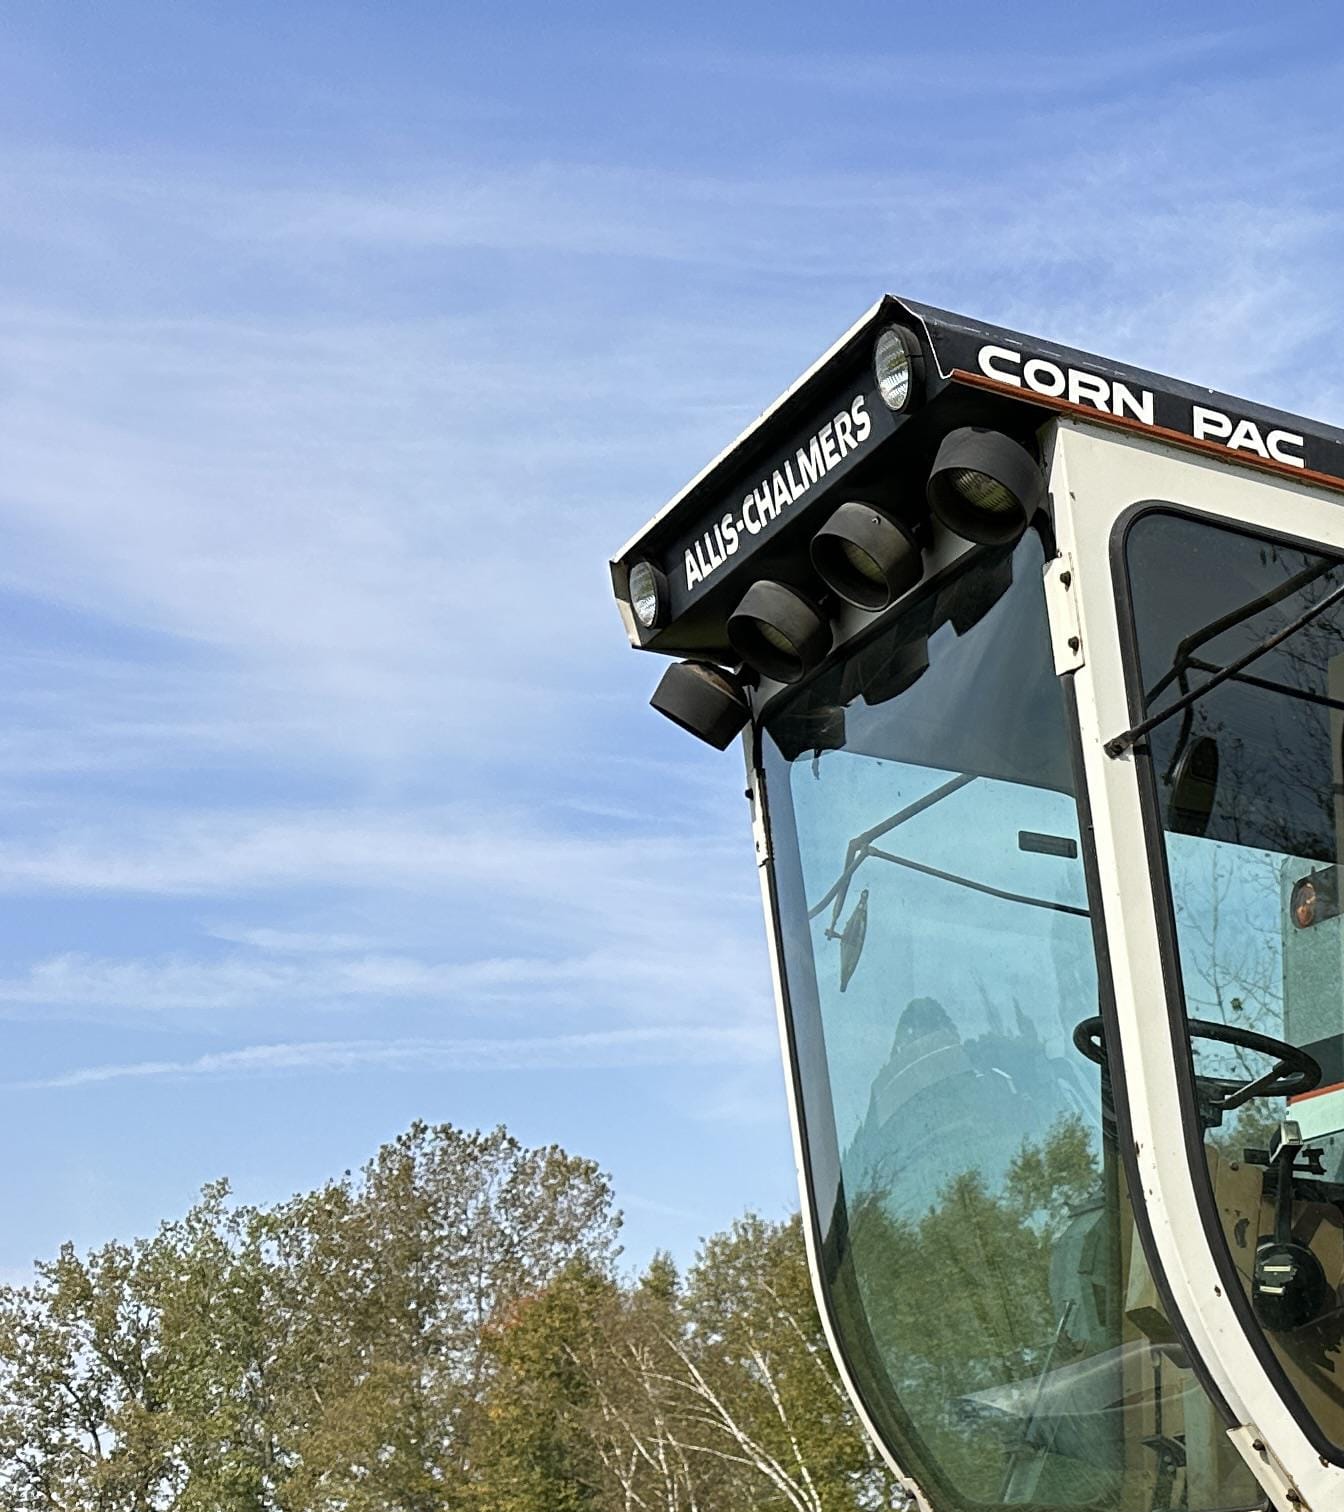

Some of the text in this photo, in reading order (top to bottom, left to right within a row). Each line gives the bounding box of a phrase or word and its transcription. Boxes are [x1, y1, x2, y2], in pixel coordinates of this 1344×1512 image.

[978, 344, 1306, 469] CORN PAC
[683, 394, 873, 591] ALLIS-CHALMERS
